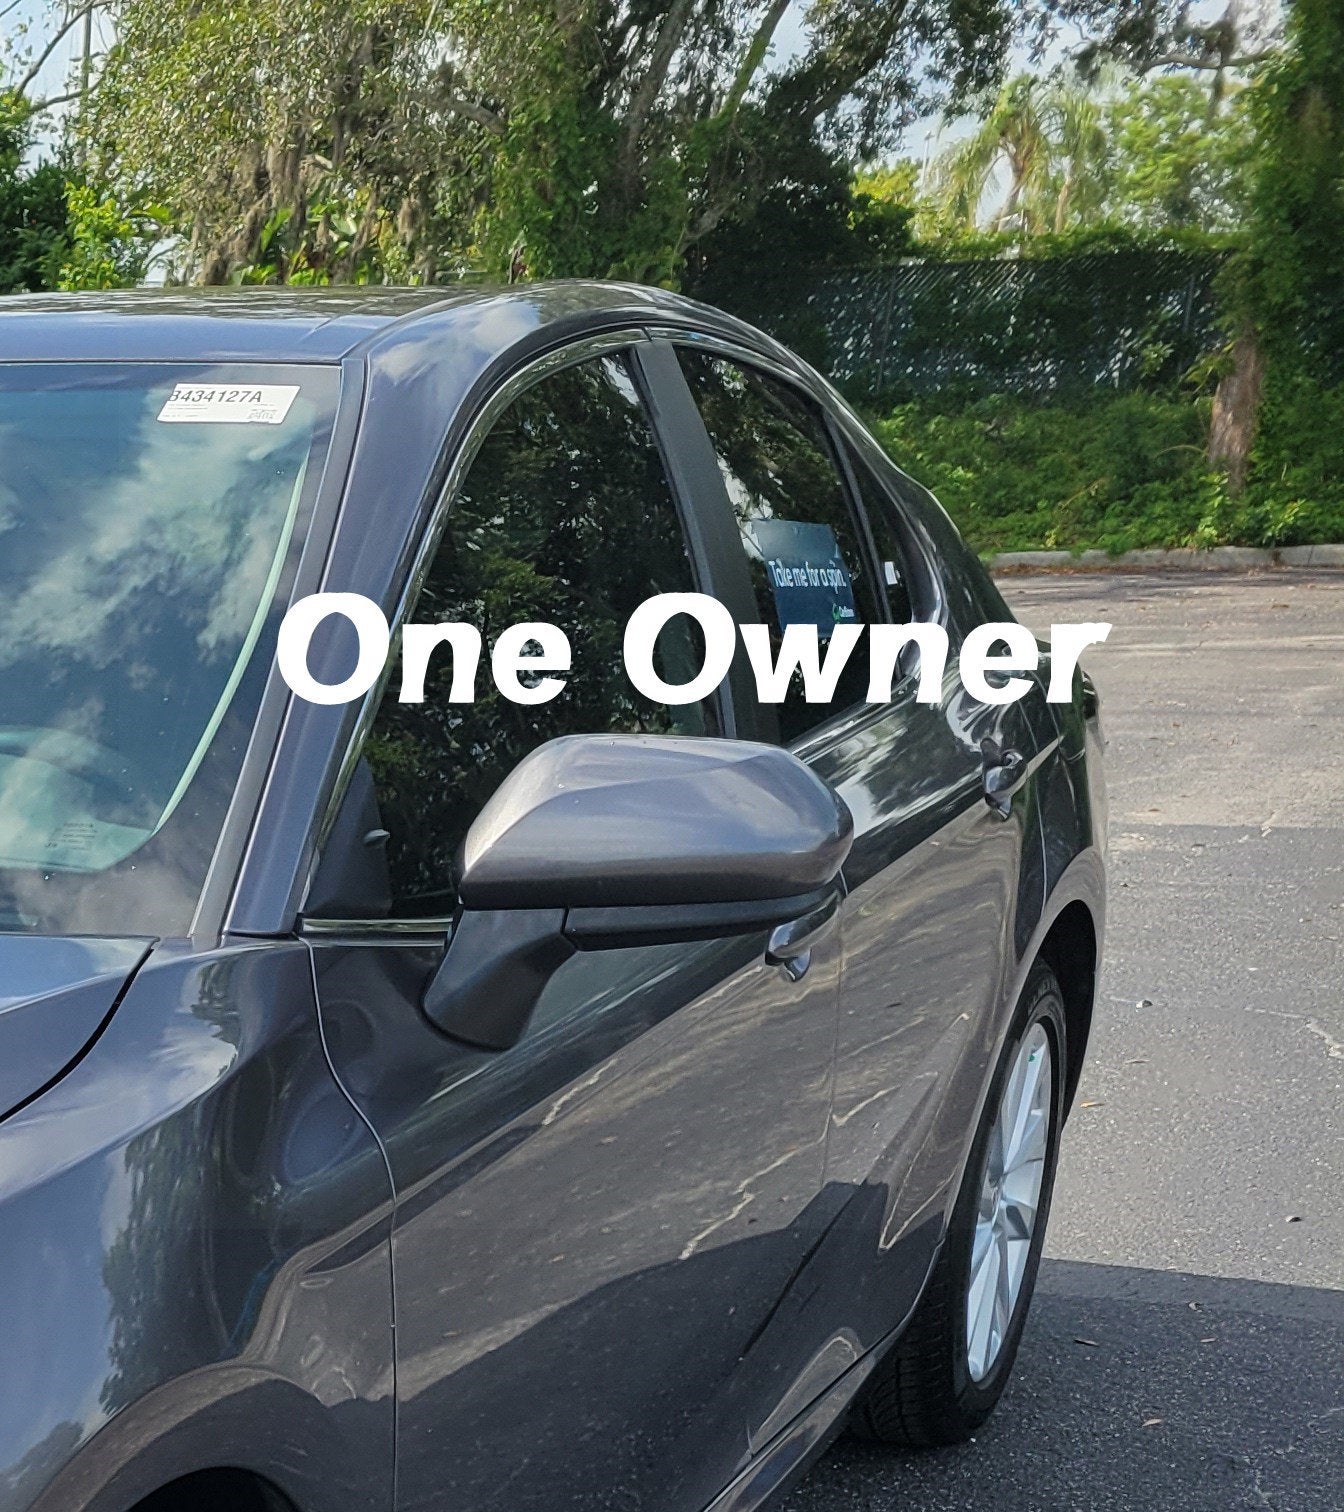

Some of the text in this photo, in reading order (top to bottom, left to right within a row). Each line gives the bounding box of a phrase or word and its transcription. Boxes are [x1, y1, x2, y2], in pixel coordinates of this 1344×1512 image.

[768, 557, 793, 588] Take
[792, 567, 809, 588] me
[805, 560, 821, 588] for
[819, 567, 830, 588] a
